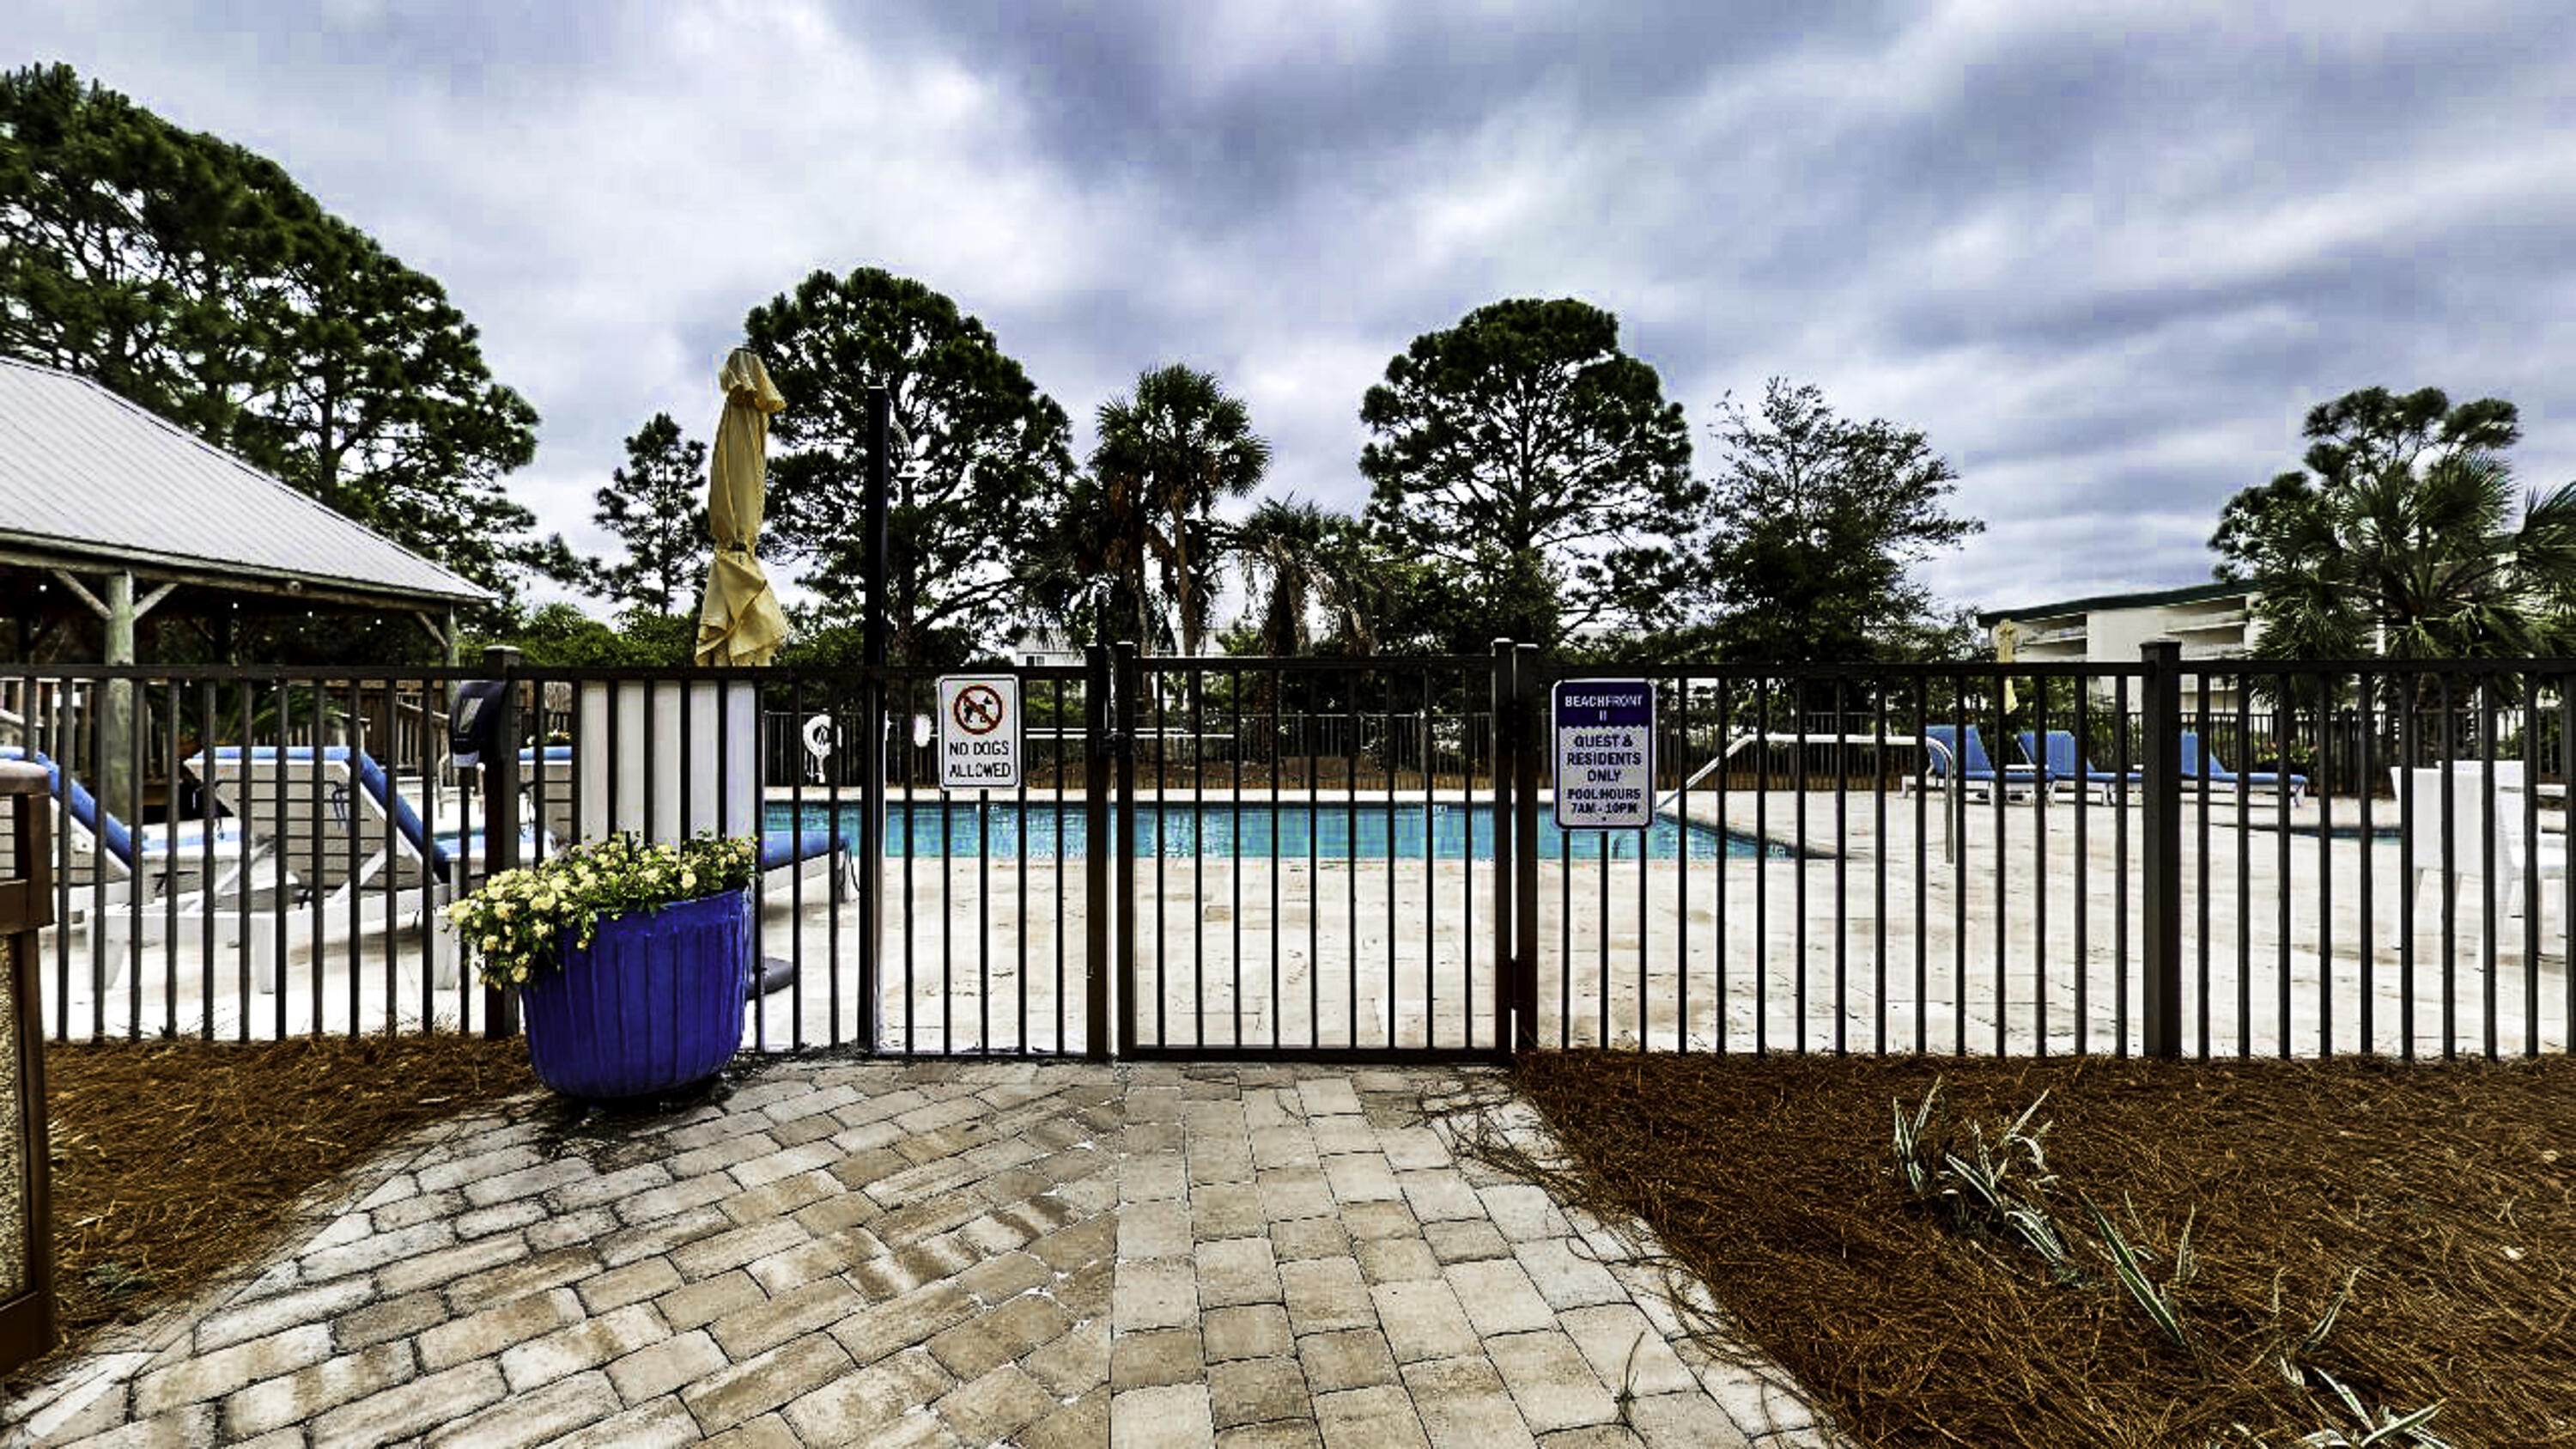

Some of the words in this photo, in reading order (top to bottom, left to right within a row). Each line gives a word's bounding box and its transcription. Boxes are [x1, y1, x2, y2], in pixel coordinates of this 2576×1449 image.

[1564, 694, 1642, 707] BEACHFRONT
[1575, 734, 1619, 747] GUEST
[1622, 734, 1633, 748] &
[949, 742, 969, 756] NO
[973, 740, 1009, 756] DOGS
[1567, 752, 1641, 765] RESIDENTS
[949, 762, 1011, 777] ALLOWED
[1587, 769, 1621, 782] ONLY
[1567, 788, 1597, 800] POOL
[1600, 788, 1641, 800] HOURS
[1571, 801, 1595, 814] 7AM
[1606, 801, 1637, 814] 10PM
